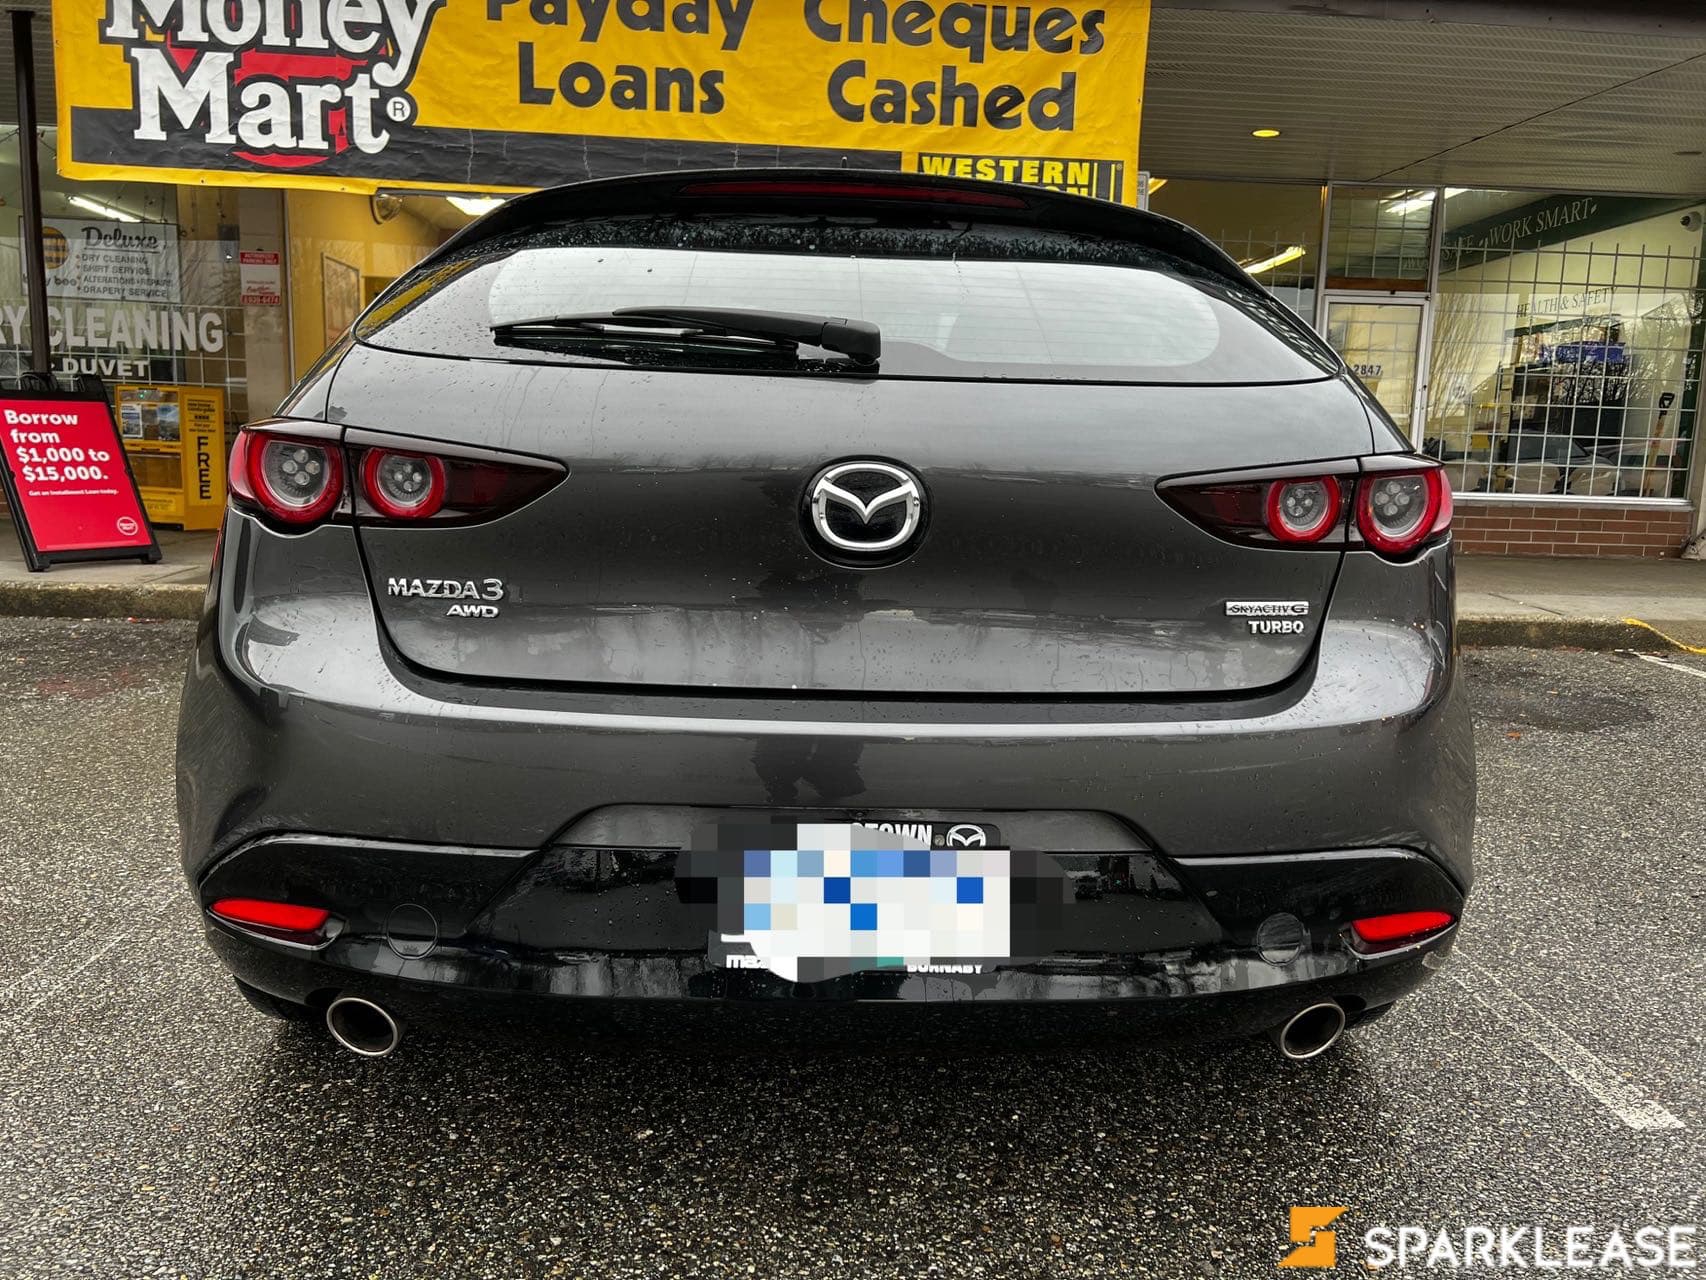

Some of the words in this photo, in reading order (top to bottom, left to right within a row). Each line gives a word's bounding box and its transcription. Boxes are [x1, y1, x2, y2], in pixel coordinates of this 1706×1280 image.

[803, 0, 1105, 63] Cheques
[518, 41, 725, 115] Loans
[131, 47, 390, 153] Mart
[827, 59, 1077, 131] Cashed
[921, 156, 1090, 185] WESTERN
[1489, 216, 1533, 246] WORK
[1535, 197, 1594, 233] SMART
[81, 226, 159, 249] Deluxe
[81, 253, 100, 262] DRY
[48, 305, 224, 353] CLEANING
[62, 357, 150, 377] DUVET
[1353, 364, 1382, 376] 2847
[4, 409, 79, 426] Borrow
[10, 428, 60, 443] from
[16, 446, 85, 464] $1,000
[88, 448, 111, 462] to
[22, 465, 109, 483] $15,000.
[197, 436, 211, 500] FREE
[446, 604, 499, 618] AWD
[1247, 620, 1305, 634] TURBO
